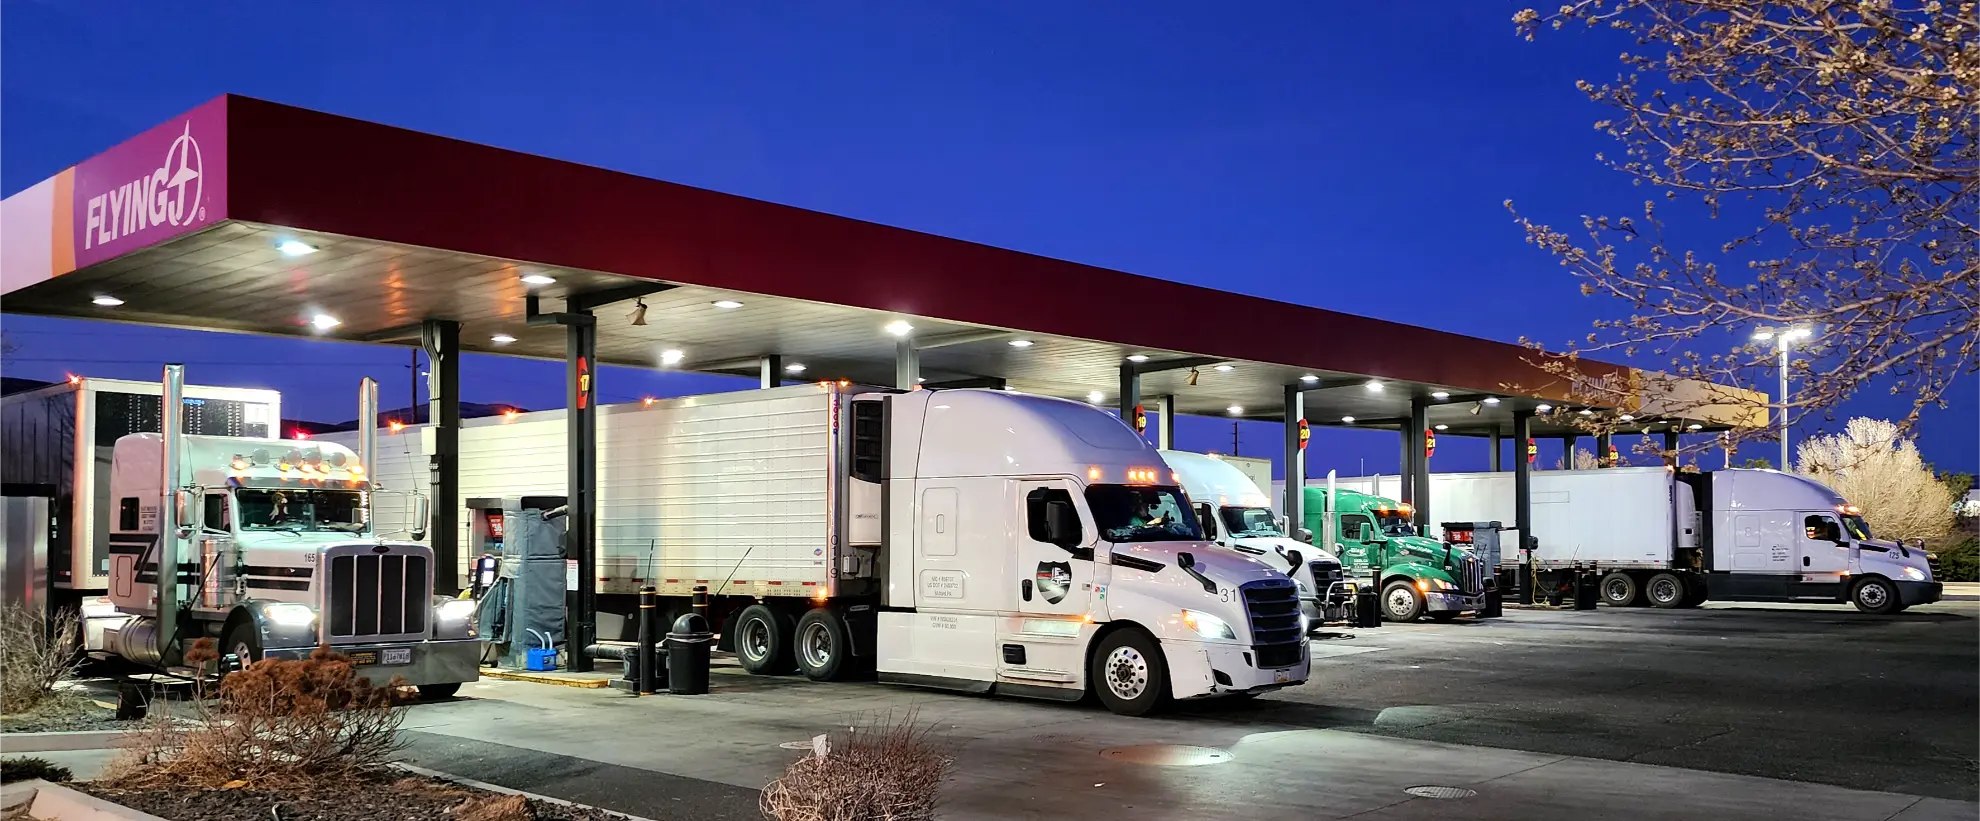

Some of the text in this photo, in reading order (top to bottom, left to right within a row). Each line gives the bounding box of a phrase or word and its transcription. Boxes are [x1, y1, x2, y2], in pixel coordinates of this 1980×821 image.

[580, 374, 590, 391] 17
[1137, 416, 1147, 428] 19
[1300, 428, 1310, 440] 20
[1427, 438, 1436, 448] 21
[1528, 445, 1537, 454] 22
[304, 553, 316, 563] 165
[1889, 552, 1900, 560] 125
[1220, 588, 1237, 603] 31
